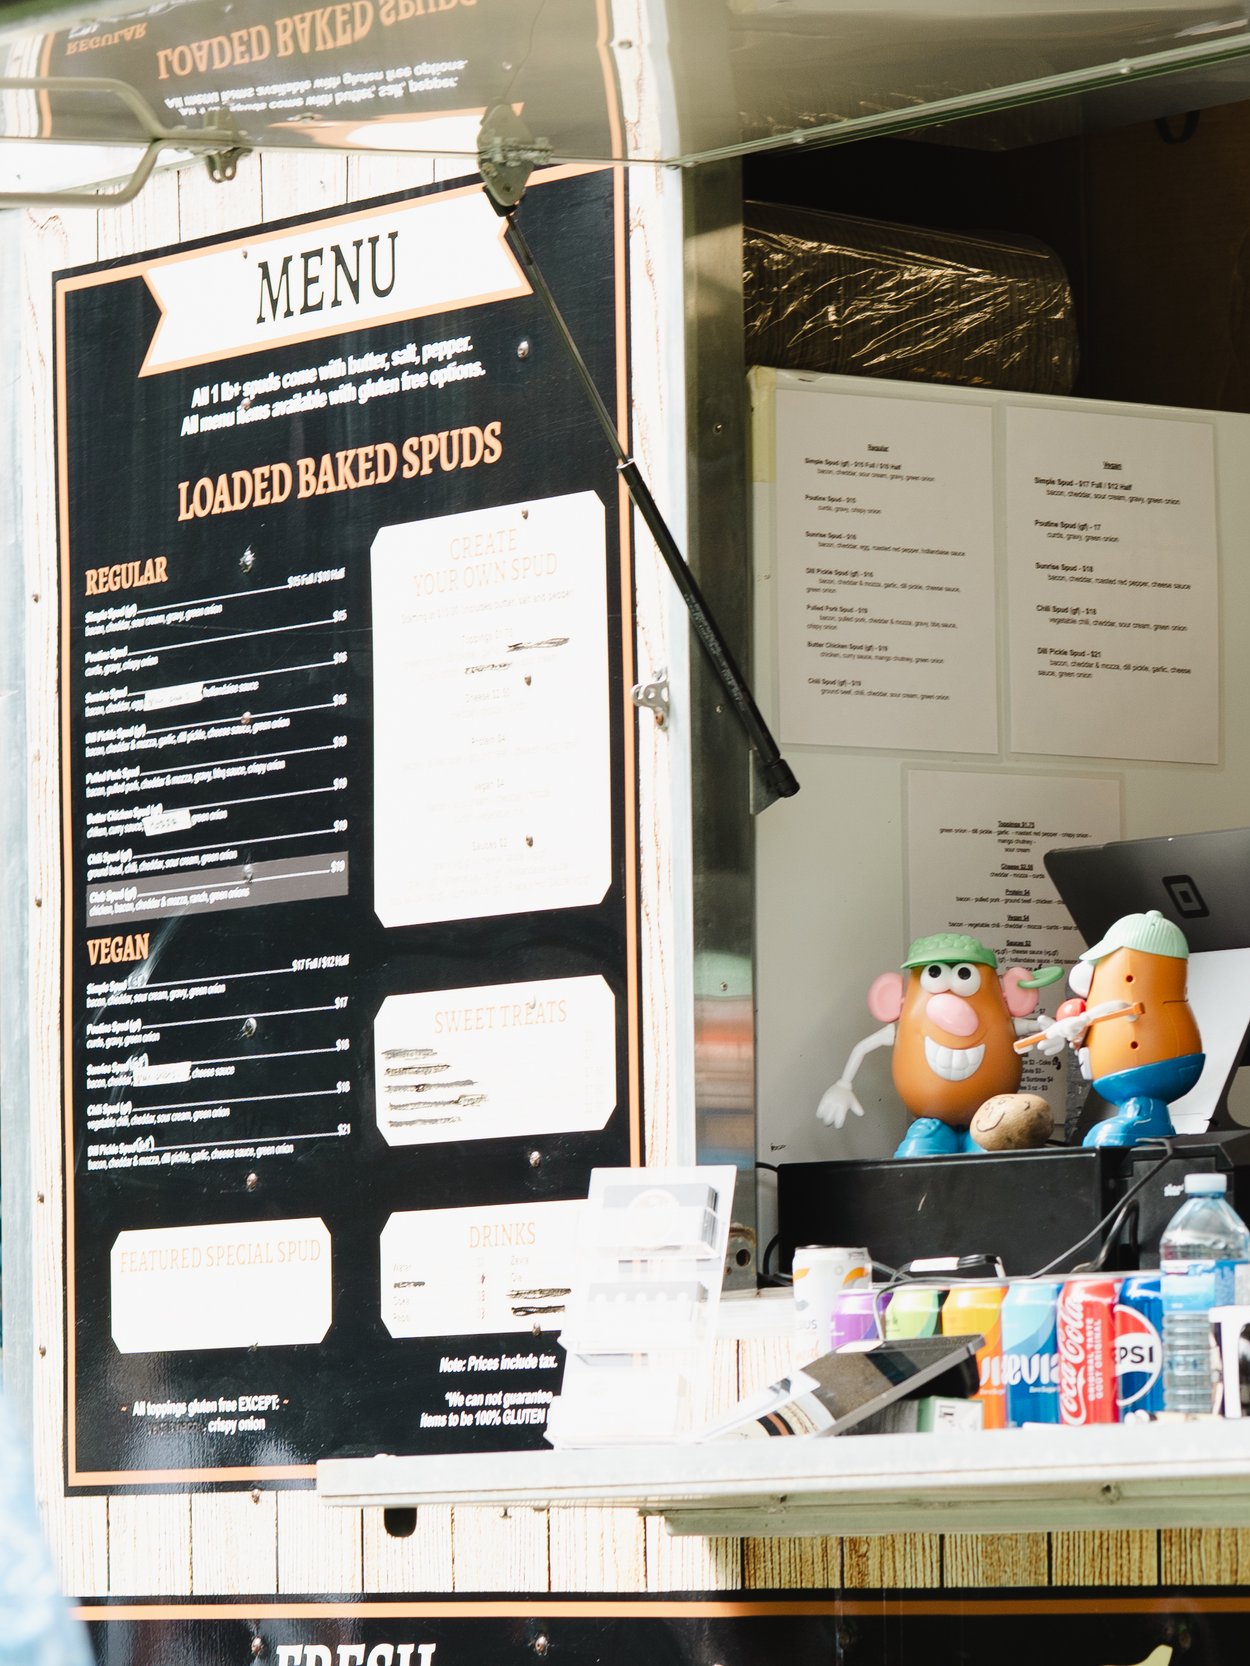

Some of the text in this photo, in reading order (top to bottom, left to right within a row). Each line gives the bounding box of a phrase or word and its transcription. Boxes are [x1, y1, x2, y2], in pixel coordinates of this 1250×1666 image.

[257, 231, 399, 325] MENU
[191, 386, 211, 409] All
[211, 384, 219, 404] 1
[242, 371, 281, 400] spuds
[281, 366, 318, 389] come
[317, 357, 347, 383] with
[347, 349, 391, 377] butter,
[391, 343, 421, 367] salt,
[420, 335, 473, 364] pepper.
[180, 360, 486, 437] All menu items available with gluten free options.
[177, 421, 503, 522] LOADED BAKED SPUDS
[450, 527, 518, 561] CREATE
[85, 556, 168, 596] REGULAR
[413, 552, 558, 598] YOUR OWN SPUD
[87, 932, 150, 966] VEGAN
[434, 999, 568, 1035] SWEET TREATS
[468, 1221, 537, 1249] DRINKS
[120, 1239, 321, 1273] FEATURED SPECIAL SPUD
[439, 1352, 559, 1373] Note: Prices include tax.
[132, 1394, 280, 1419] All toppings gluten free EXCEPT:
[465, 1393, 485, 1407] can
[484, 1390, 503, 1406] not
[208, 1416, 238, 1435] crispy
[238, 1415, 266, 1431] onion
[447, 1411, 460, 1427] to
[459, 1411, 474, 1427] be
[474, 1408, 502, 1426] 100%
[502, 1408, 547, 1425] GLUTEN
